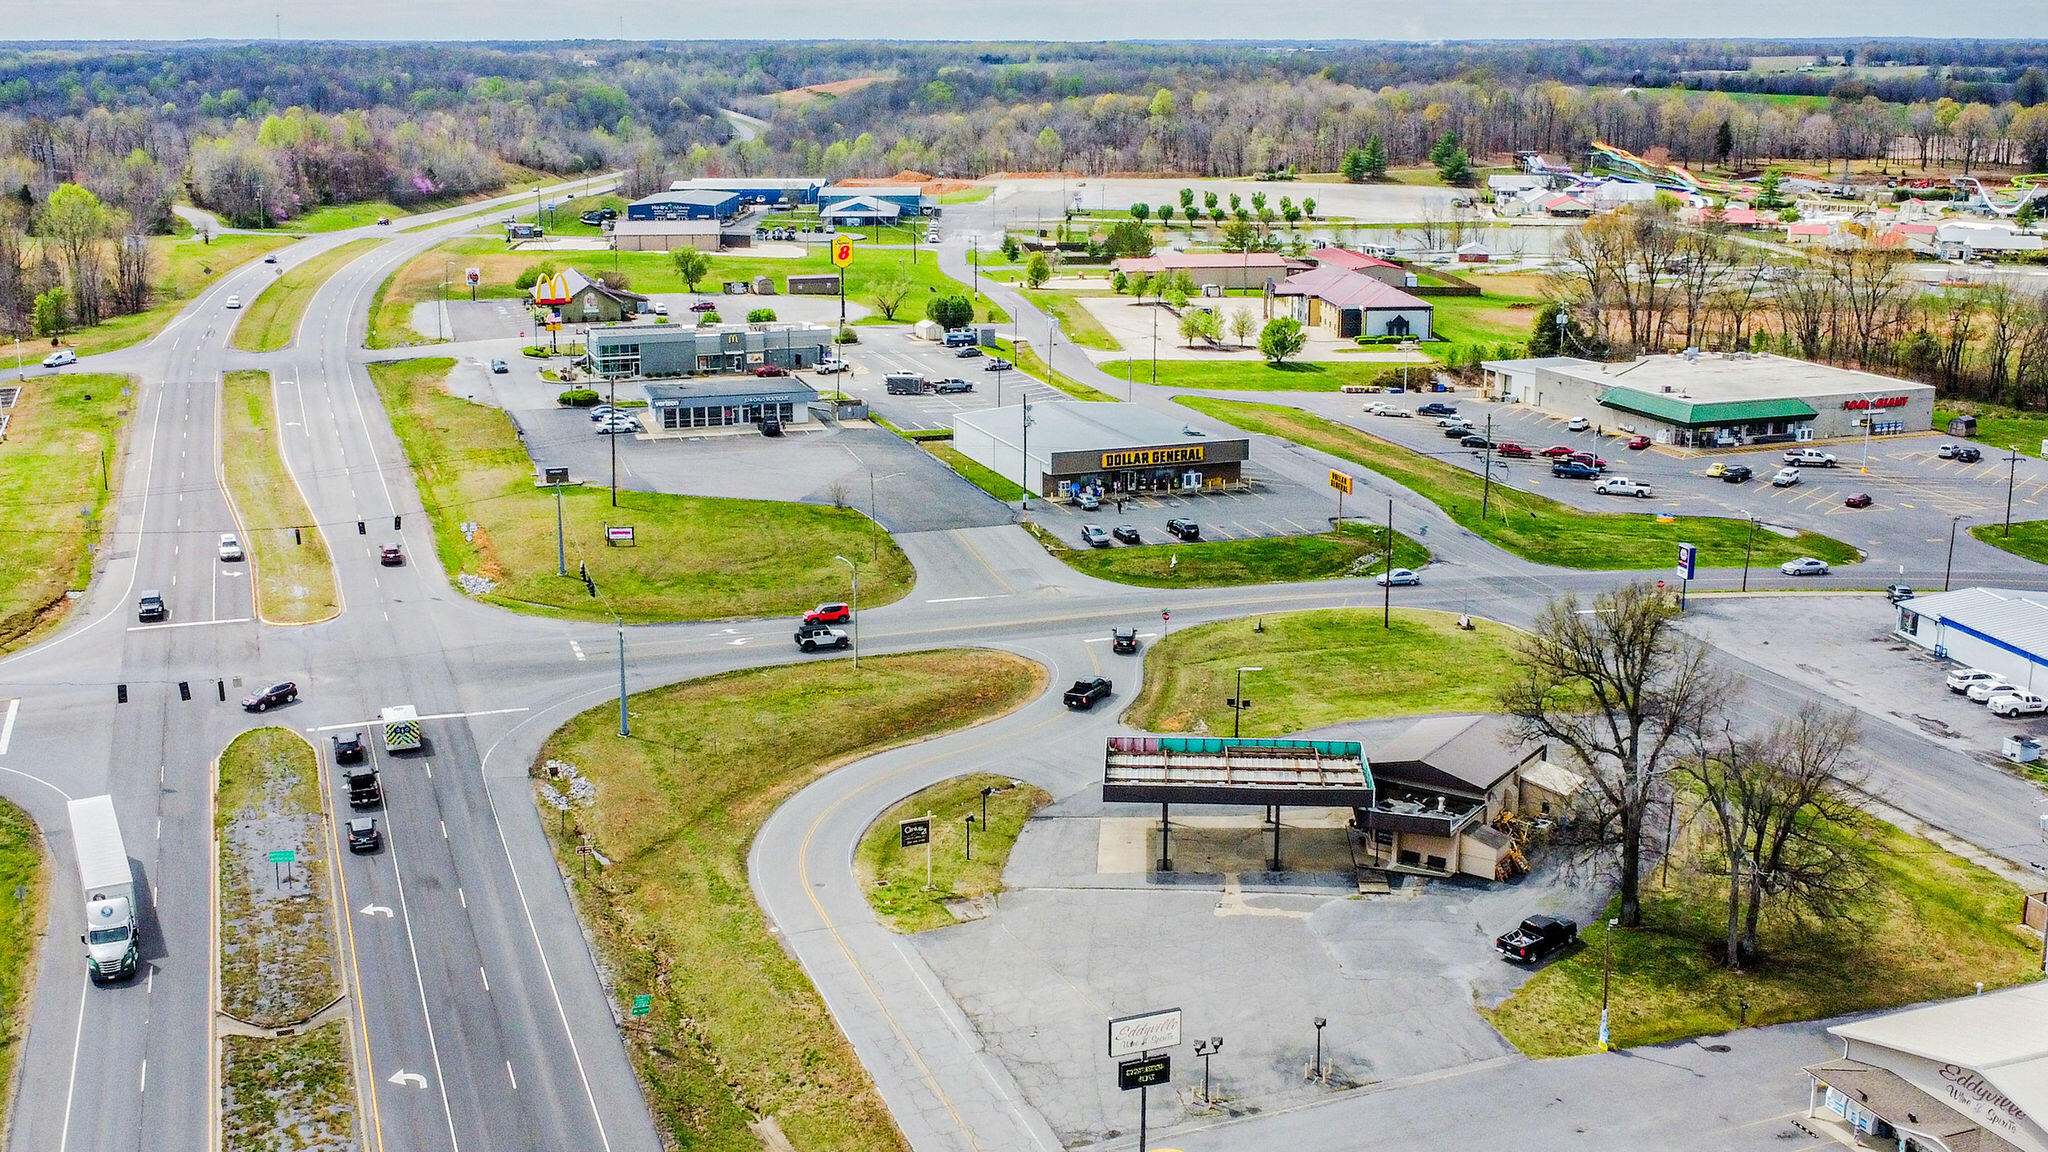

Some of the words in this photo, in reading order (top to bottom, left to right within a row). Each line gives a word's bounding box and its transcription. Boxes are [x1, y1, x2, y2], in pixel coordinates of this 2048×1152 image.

[838, 245, 850, 260] 8
[1875, 396, 1908, 409] GIANT
[1106, 452, 1150, 467] DOLLAR
[1152, 448, 1202, 463] GENERAL
[1115, 1018, 1178, 1041] Eddyville
[1939, 1064, 2027, 1120] Eddyville
[1945, 1084, 1971, 1106] Wine
[1986, 1108, 2018, 1134] Spirits
